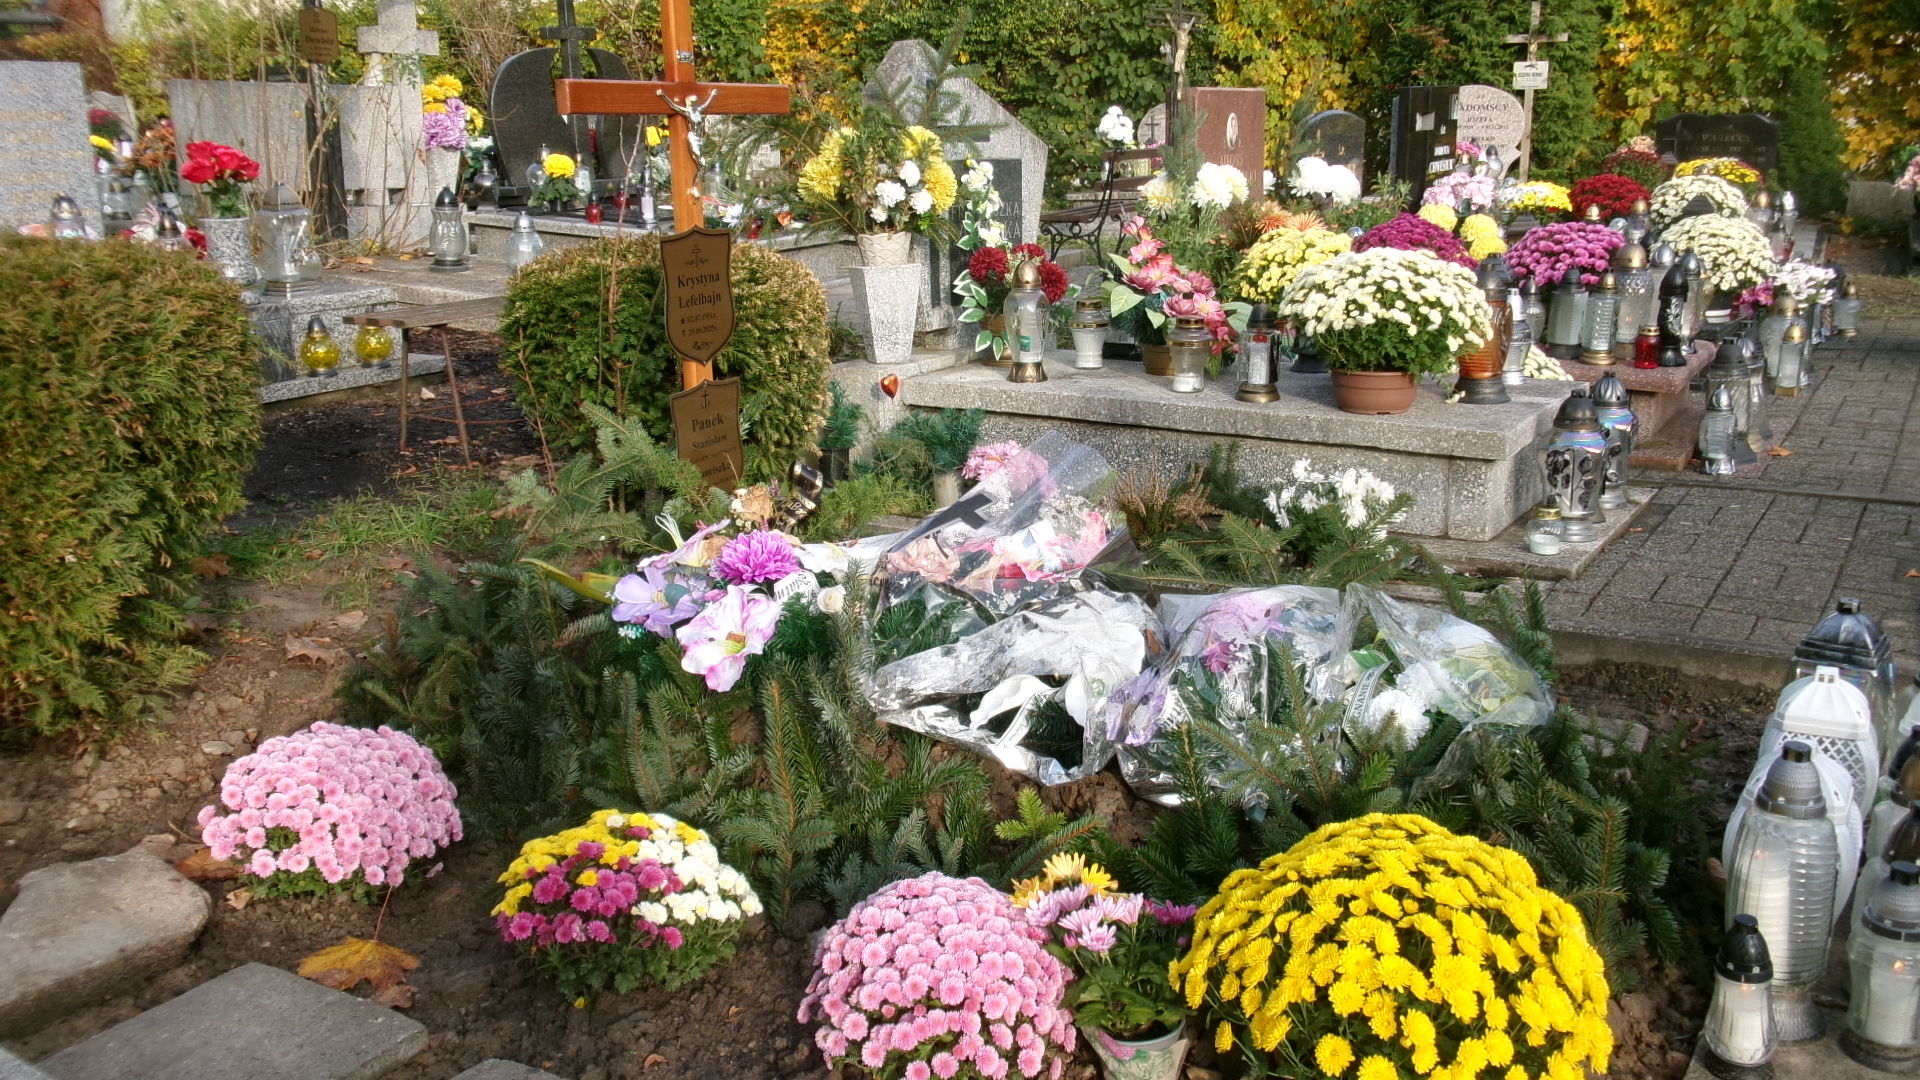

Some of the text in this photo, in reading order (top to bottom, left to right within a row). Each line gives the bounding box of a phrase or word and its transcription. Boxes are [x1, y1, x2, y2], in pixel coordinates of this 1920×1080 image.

[1459, 103, 1509, 112] ADOMSCY
[677, 272, 721, 289] Krystyna
[678, 290, 722, 309] Lefelbajn
[692, 412, 724, 433] Panek
